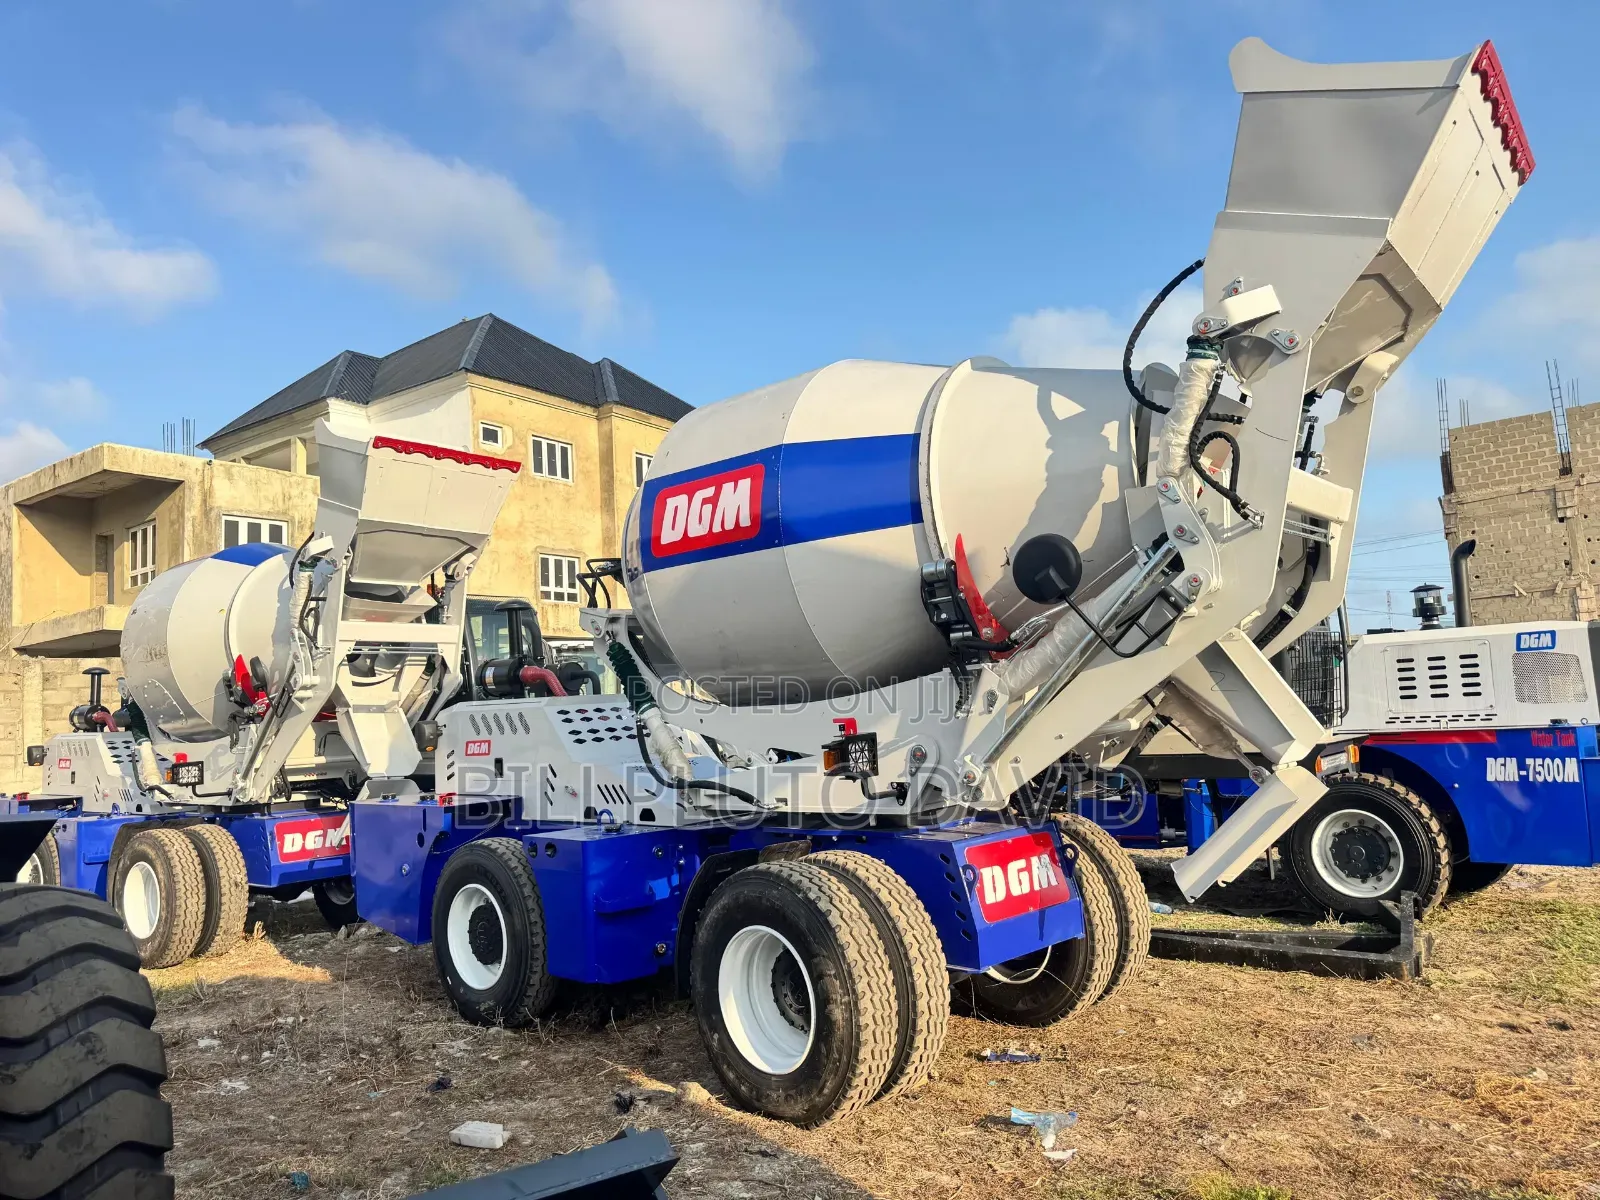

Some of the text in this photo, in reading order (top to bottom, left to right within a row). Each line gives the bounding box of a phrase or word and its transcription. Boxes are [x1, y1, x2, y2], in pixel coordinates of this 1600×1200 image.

[660, 477, 752, 545] DGM
[1520, 632, 1553, 649] DGM
[467, 742, 489, 755] DGM
[1530, 729, 1576, 747] Water Tank
[1486, 757, 1580, 782] DGM-7500M
[282, 828, 347, 853] DGM
[980, 853, 1058, 905] DGM
